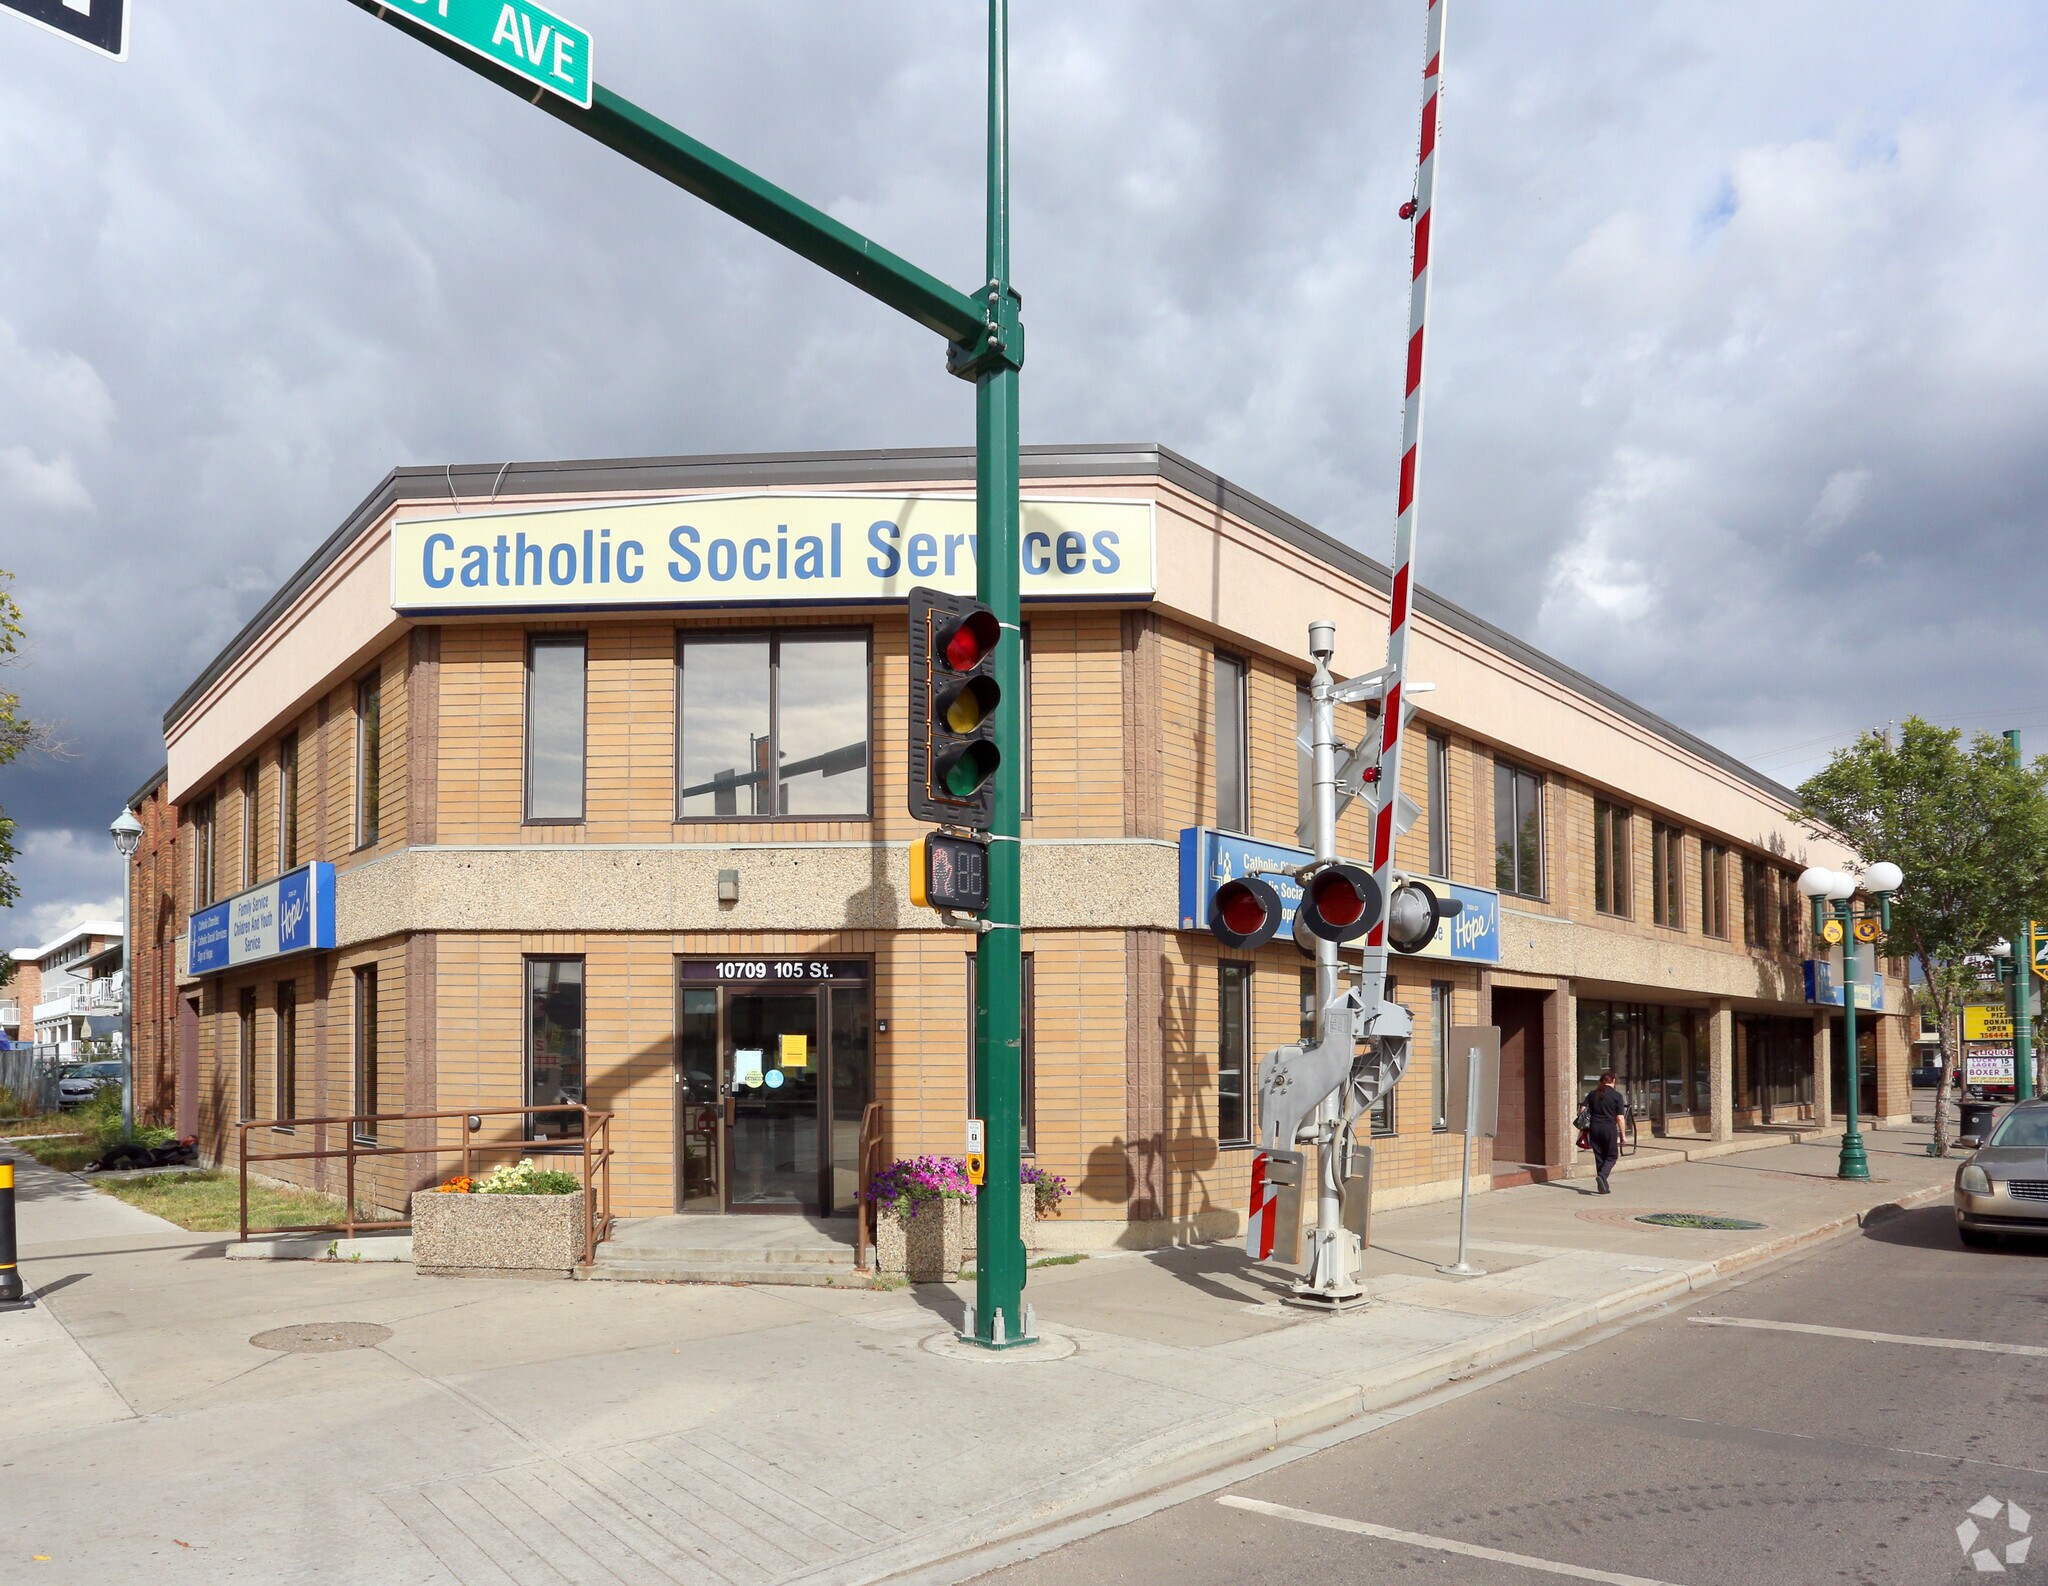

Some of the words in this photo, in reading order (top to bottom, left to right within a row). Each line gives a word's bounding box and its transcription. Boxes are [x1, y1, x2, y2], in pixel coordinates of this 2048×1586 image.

[491, 3, 575, 84] AVE
[423, 528, 644, 588] Catholic
[667, 522, 842, 583] Social
[867, 520, 1120, 578] Serces
[1281, 883, 1305, 900] Socia
[238, 901, 252, 917] Family
[252, 894, 269, 912] Service
[234, 920, 250, 937] Children
[251, 915, 260, 931] And
[260, 911, 272, 929] Youth
[244, 936, 261, 952] Service
[715, 962, 767, 979] 10709
[773, 962, 804, 979] 105
[809, 962, 834, 978] St.
